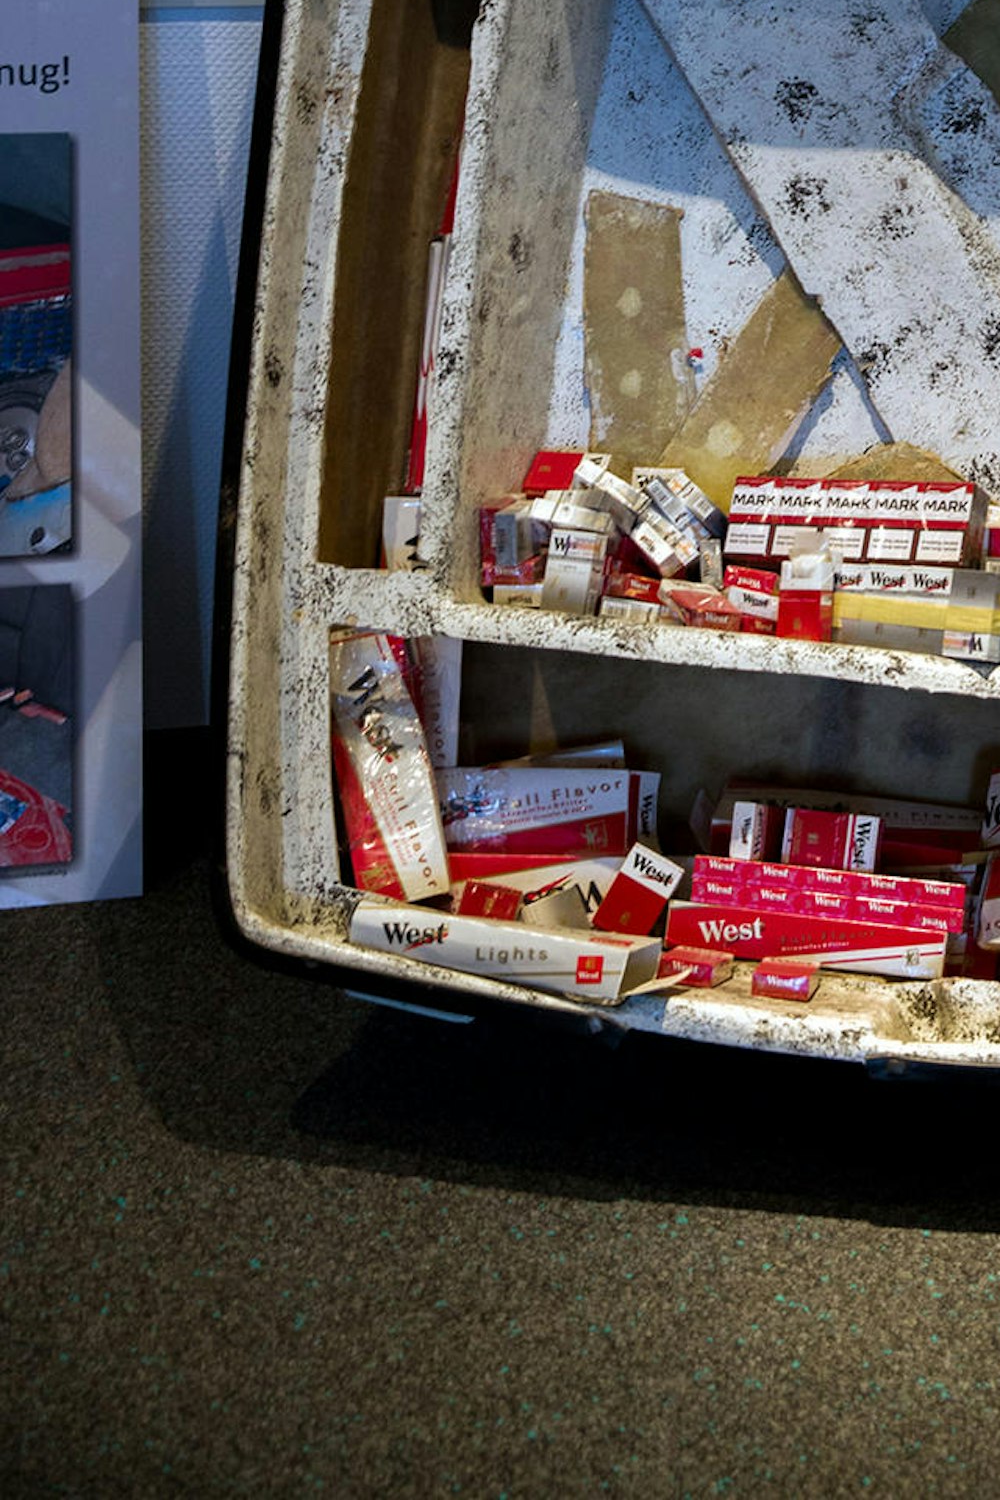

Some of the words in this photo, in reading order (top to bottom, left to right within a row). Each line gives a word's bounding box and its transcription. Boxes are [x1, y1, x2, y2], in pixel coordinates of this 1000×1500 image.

[733, 493, 776, 507] MARK
[779, 495, 823, 509] MARK
[826, 496, 871, 510] MARK
[874, 498, 920, 511] MARK
[923, 500, 969, 513] MARK
[834, 572, 863, 588] est
[870, 571, 906, 589] West
[913, 573, 950, 591] West
[552, 779, 622, 801] Flavor
[853, 820, 871, 867] West
[403, 819, 438, 890] Flavor
[633, 852, 674, 887] West
[709, 860, 736, 872] West
[762, 865, 789, 878] West
[816, 871, 843, 884] West
[870, 877, 897, 890] West
[707, 883, 733, 896] West
[760, 888, 787, 901] West
[924, 883, 951, 896] West
[814, 894, 841, 908] West
[868, 901, 895, 914] West
[699, 916, 765, 943] West
[382, 922, 449, 950] West
[475, 947, 549, 965] Lights
[577, 970, 599, 980] West
